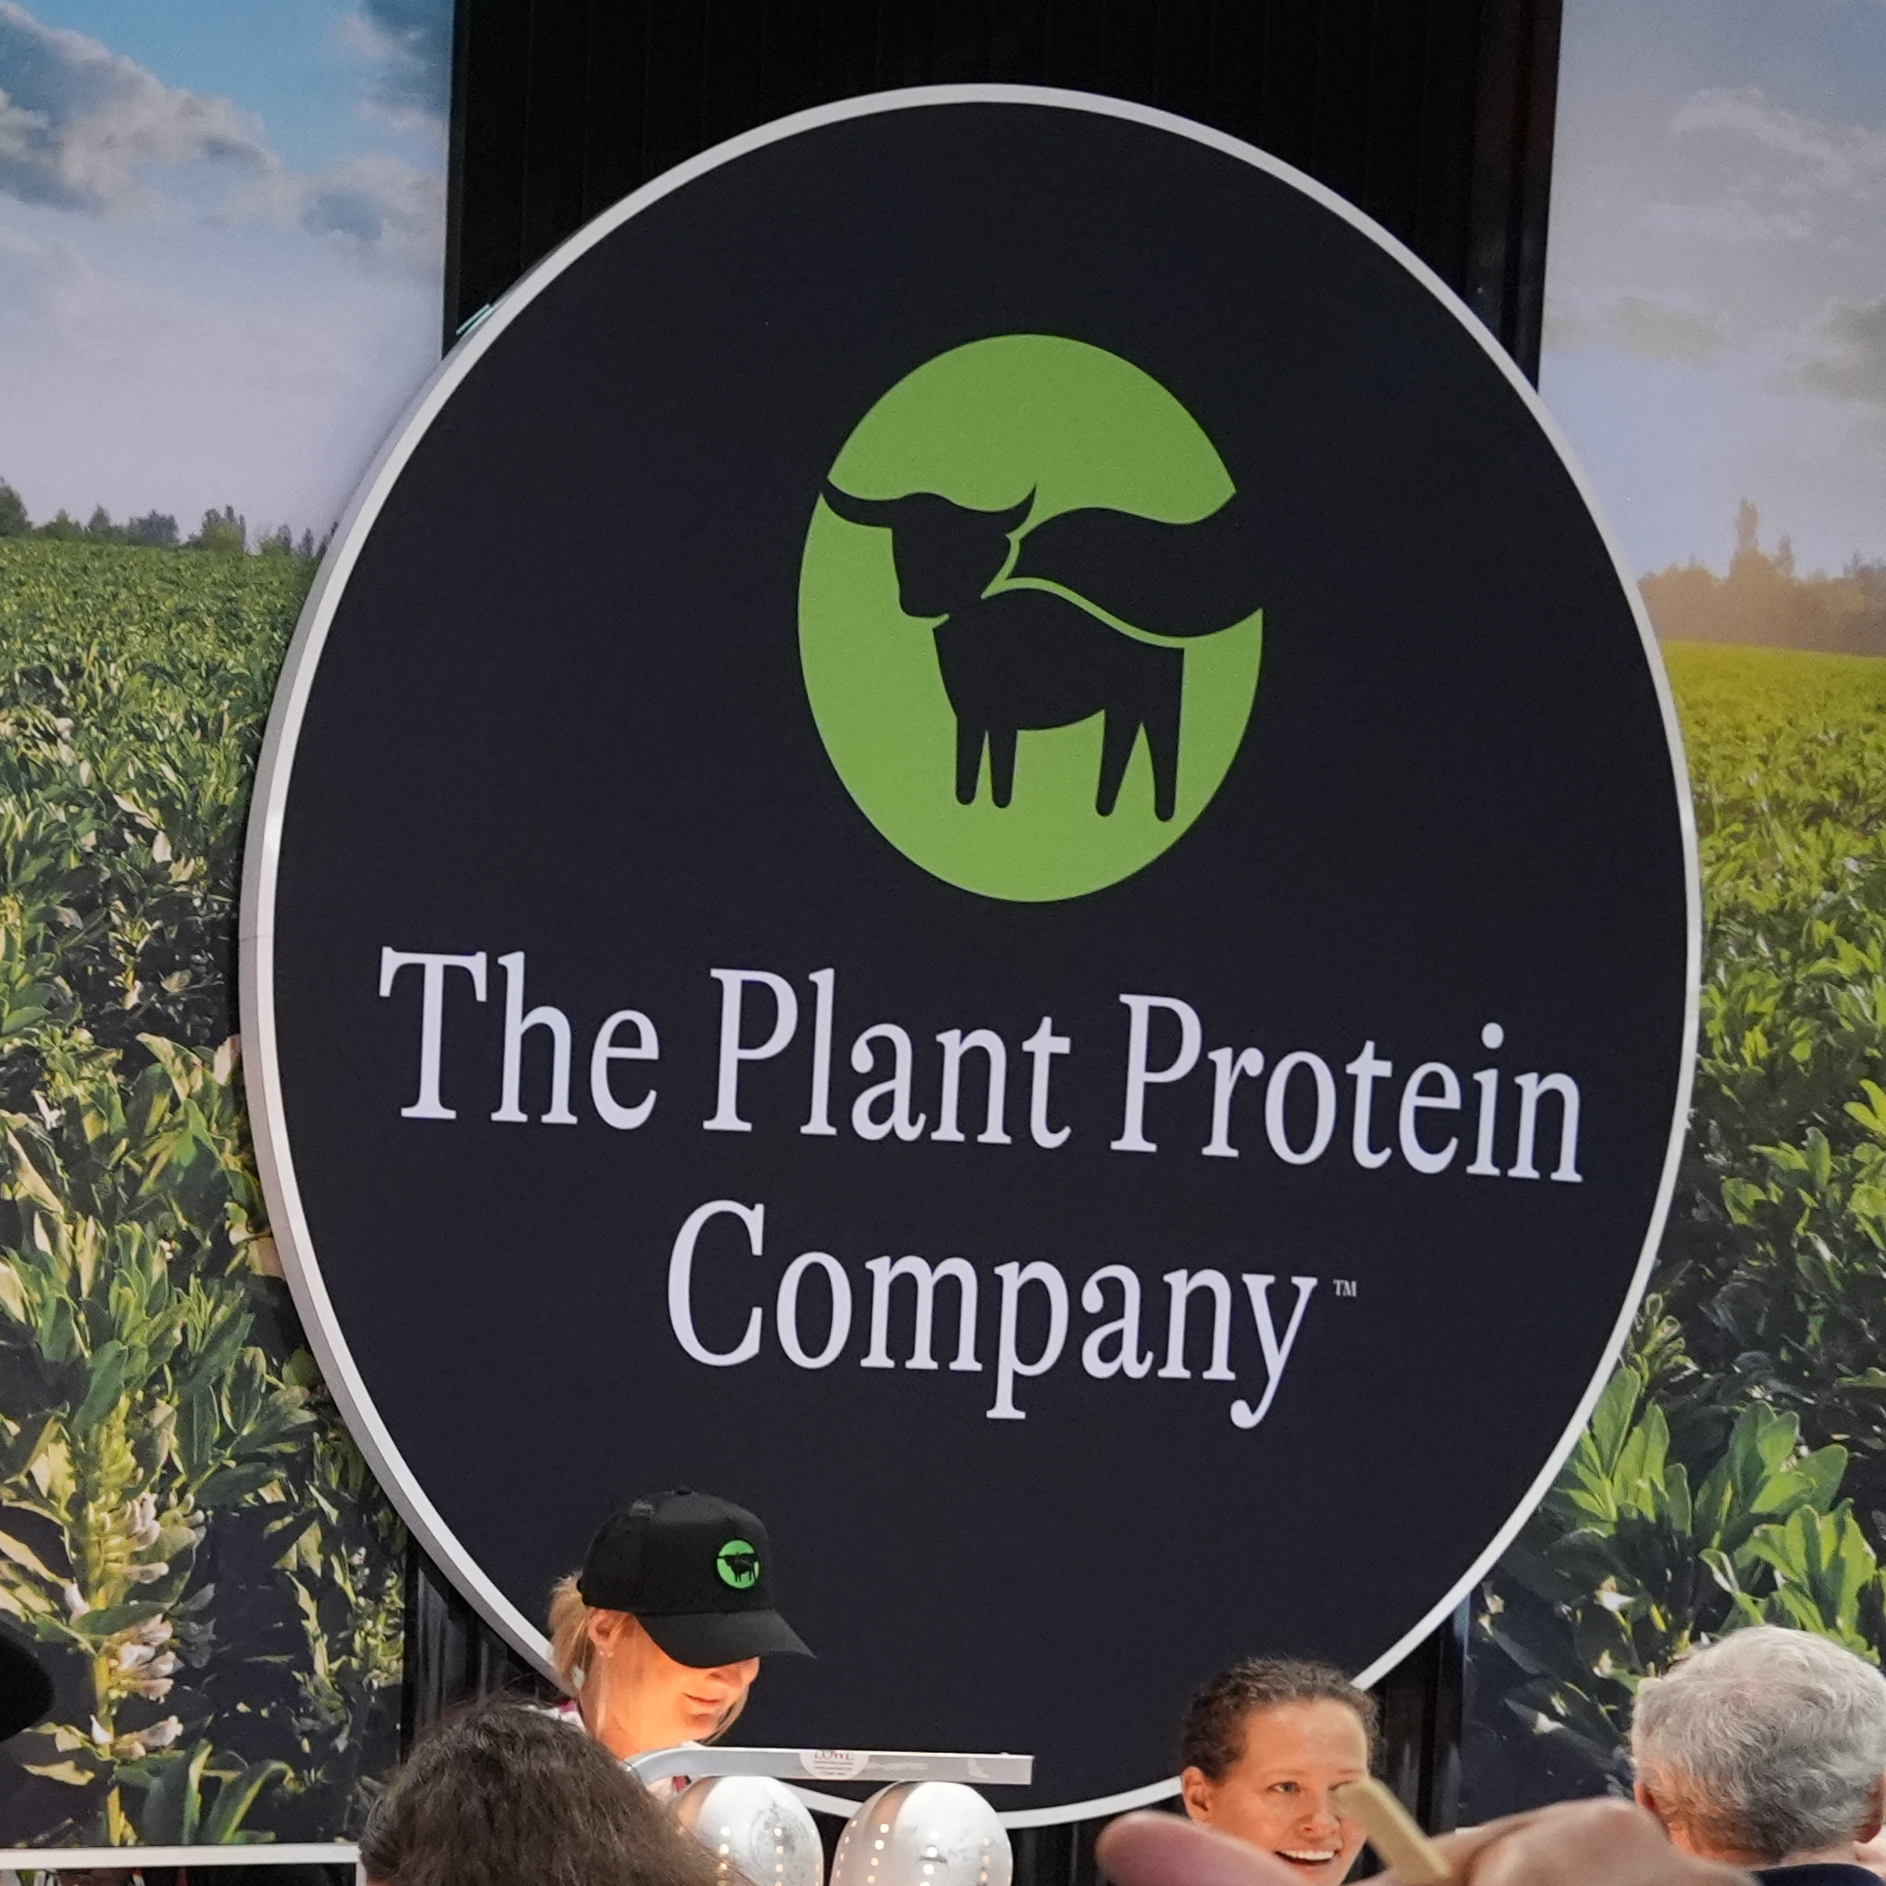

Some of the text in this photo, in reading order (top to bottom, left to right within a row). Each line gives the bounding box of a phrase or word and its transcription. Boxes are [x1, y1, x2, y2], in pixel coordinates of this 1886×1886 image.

[379, 947, 1587, 1186] The Plant Protein
